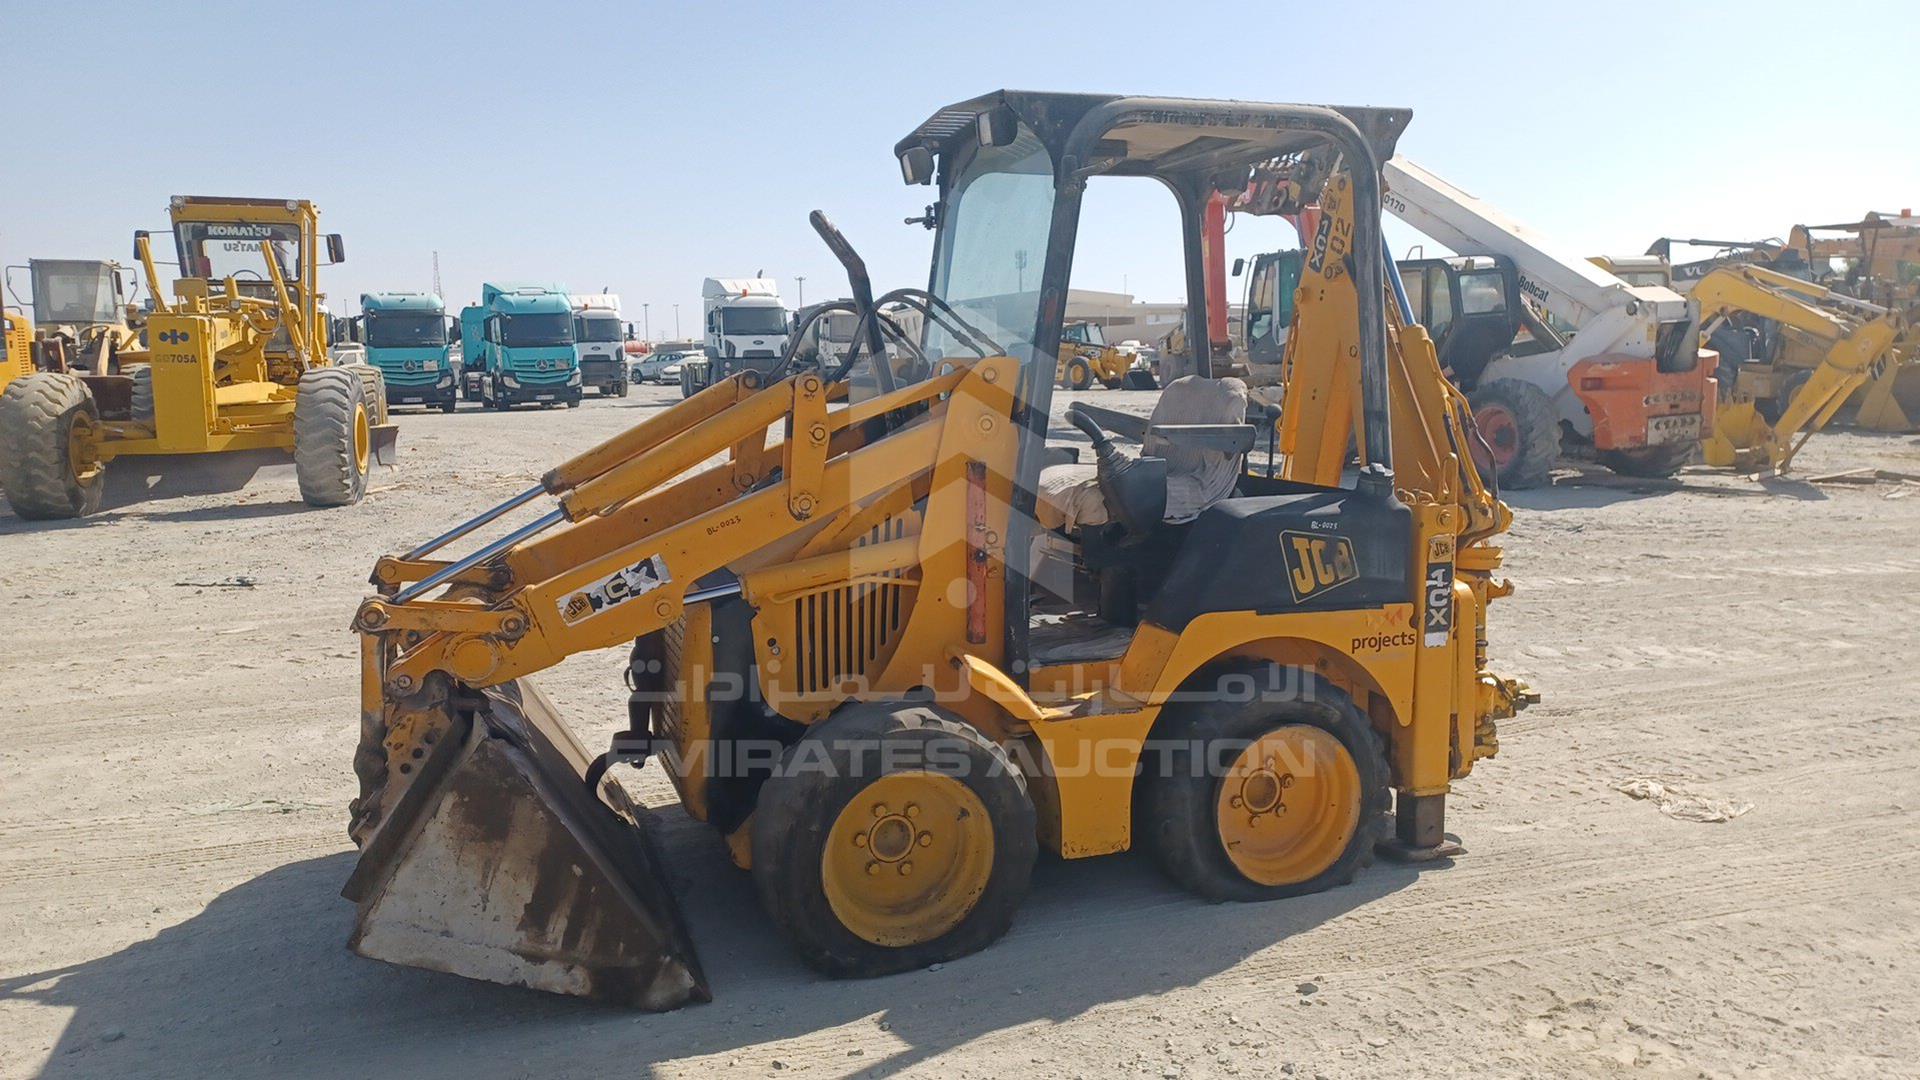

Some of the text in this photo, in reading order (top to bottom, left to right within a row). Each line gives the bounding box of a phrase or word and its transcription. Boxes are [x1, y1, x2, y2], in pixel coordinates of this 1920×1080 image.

[207, 225, 272, 236] KOMATSU
[1519, 275, 1549, 302] Bobcat
[1434, 542, 1451, 557] JCB
[1292, 536, 1353, 594] JCB
[567, 597, 590, 619] JCB
[1352, 632, 1416, 653] projects
